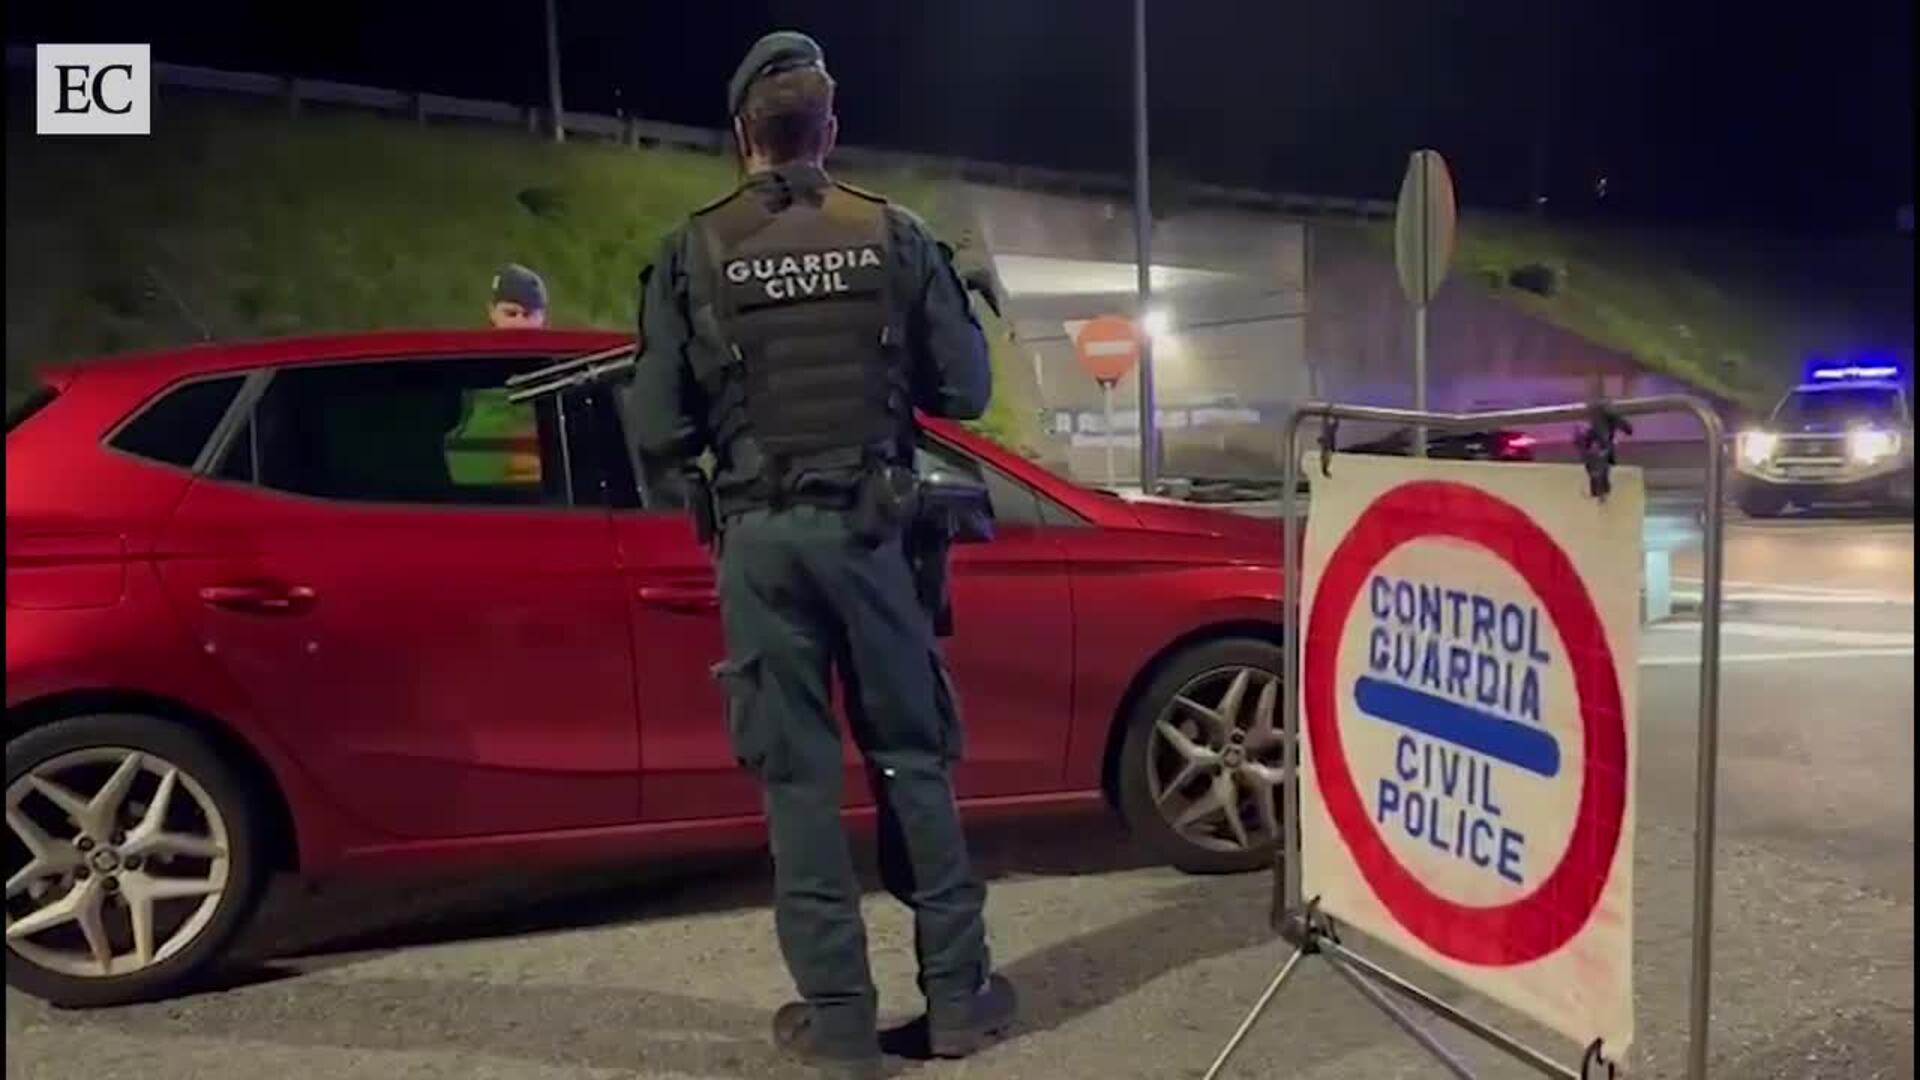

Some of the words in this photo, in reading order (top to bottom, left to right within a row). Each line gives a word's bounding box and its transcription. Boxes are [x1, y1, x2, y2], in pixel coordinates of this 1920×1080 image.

[726, 248, 881, 282] GUARDIA
[765, 272, 849, 299] CIVIL
[1370, 574, 1550, 663] CONTROL
[1370, 626, 1542, 721] GUARDIA
[1396, 735, 1501, 816] CIVIL
[1377, 779, 1525, 884] POLICE
